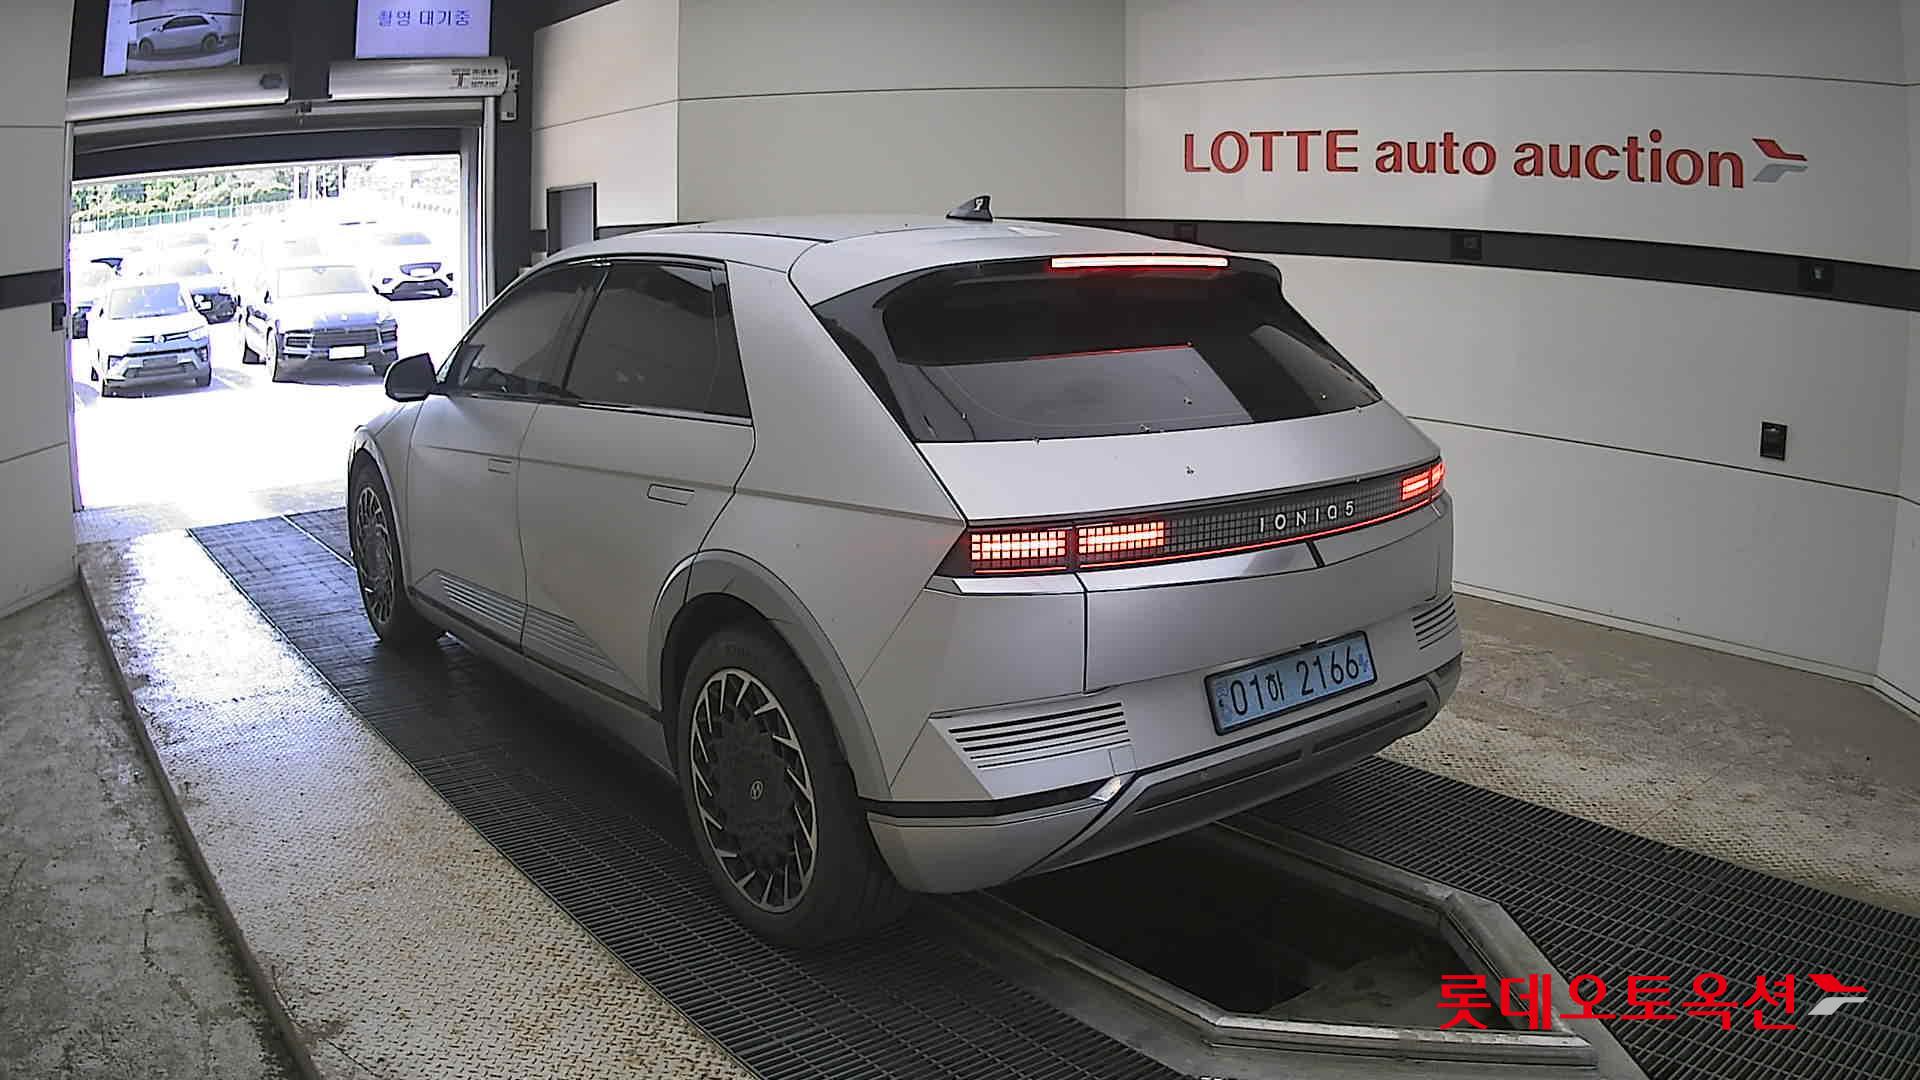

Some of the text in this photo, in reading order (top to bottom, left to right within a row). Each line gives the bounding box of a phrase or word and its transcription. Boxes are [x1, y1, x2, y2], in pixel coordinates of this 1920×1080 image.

[420, 10, 471, 26] 대기중
[1184, 129, 1744, 188] LOTTE auto auction
[1296, 646, 1359, 696] 2166
